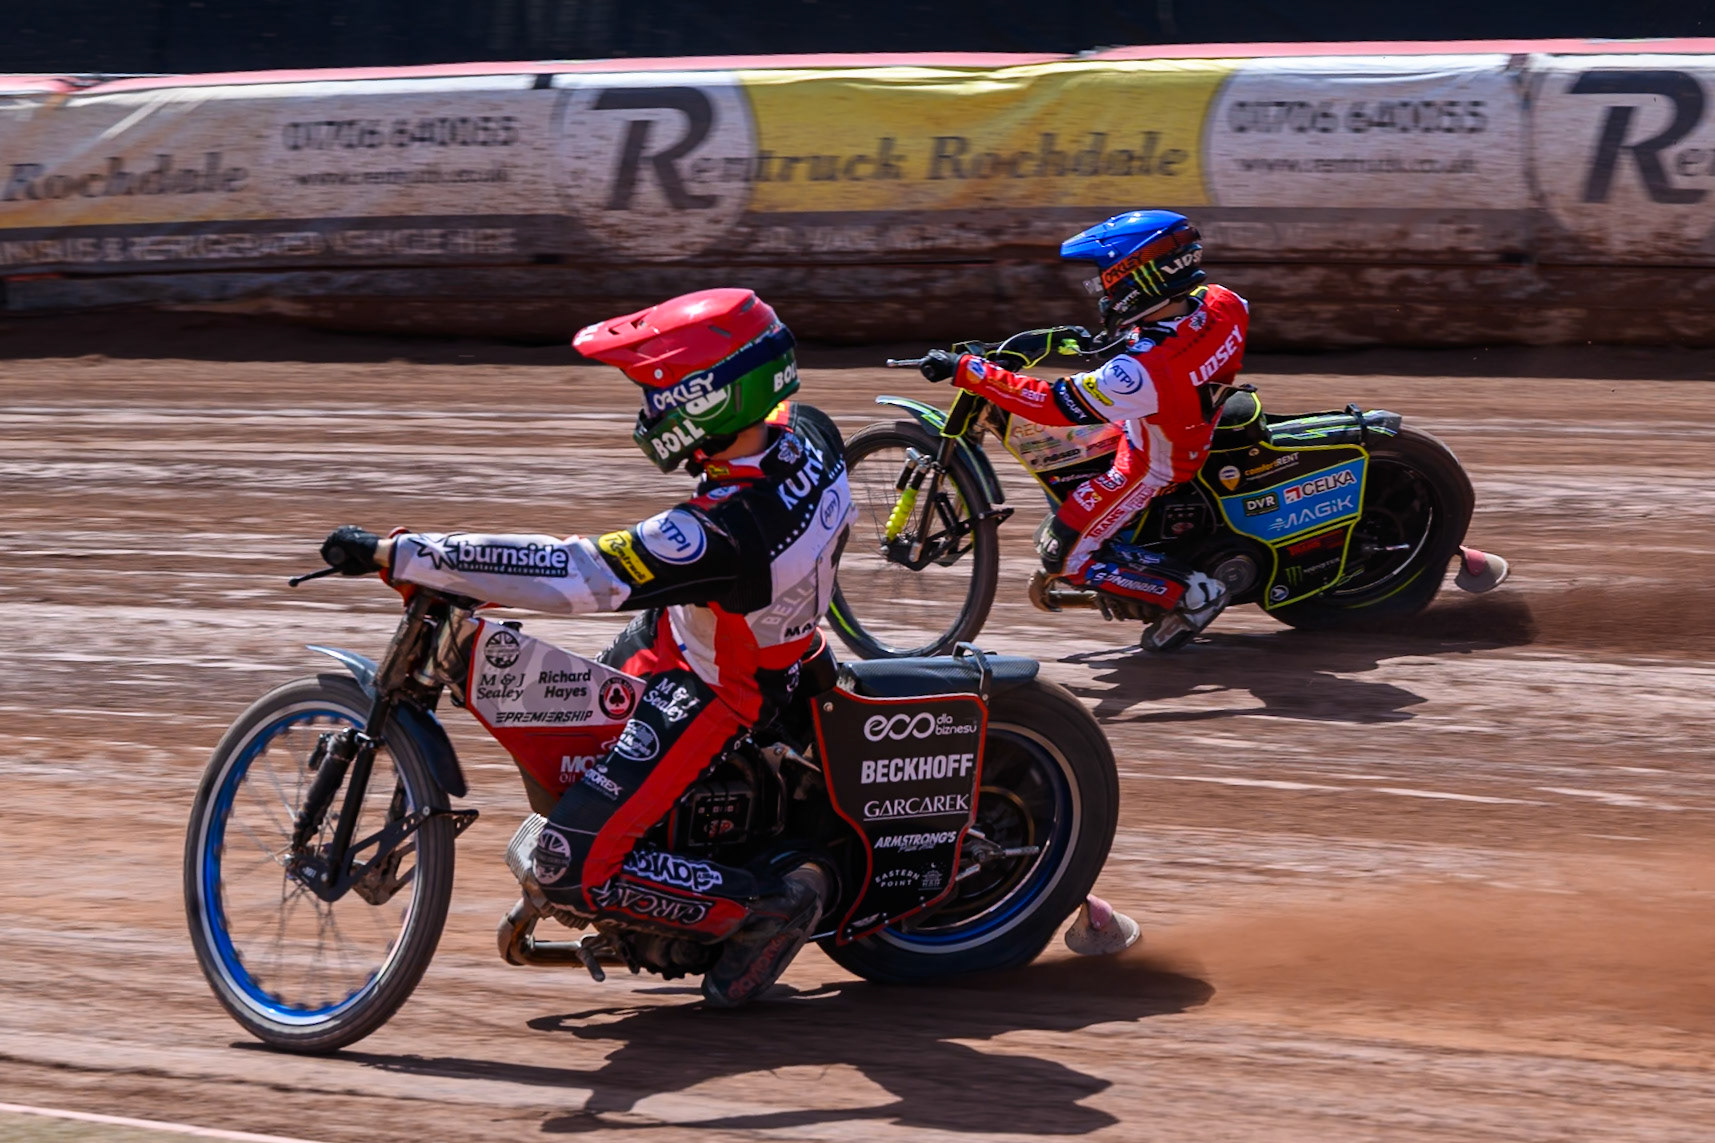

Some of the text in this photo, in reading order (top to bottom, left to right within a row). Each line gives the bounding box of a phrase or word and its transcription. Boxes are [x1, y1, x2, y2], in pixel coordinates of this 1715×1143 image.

[927, 130, 1189, 181] Rochdale
[1104, 252, 1143, 285] OAKLEY
[1188, 325, 1244, 387] LIDSEY
[1110, 364, 1136, 388] ATPI
[653, 372, 714, 411] OAKLEY
[651, 420, 705, 460] BOLL
[1302, 471, 1356, 496] CELKA
[1246, 495, 1276, 511] DVR
[656, 517, 691, 553] ATPI
[459, 540, 568, 568] burnside
[480, 674, 498, 686] M
[500, 672, 518, 686] &
[538, 668, 592, 685] Richard
[477, 686, 524, 703] Sealey
[544, 684, 588, 699] Hayes
[655, 677, 701, 710] M & J
[642, 689, 689, 723] Sealey
[863, 711, 936, 742] eco
[935, 723, 977, 736] biznesu
[559, 772, 577, 784] Oil
[861, 753, 975, 785] BECKHOFF
[863, 793, 970, 819] GARCAREK
[873, 831, 958, 849] ARMSTRONG'S
[874, 869, 920, 883] EASTERN
[880, 879, 912, 888] POINT
